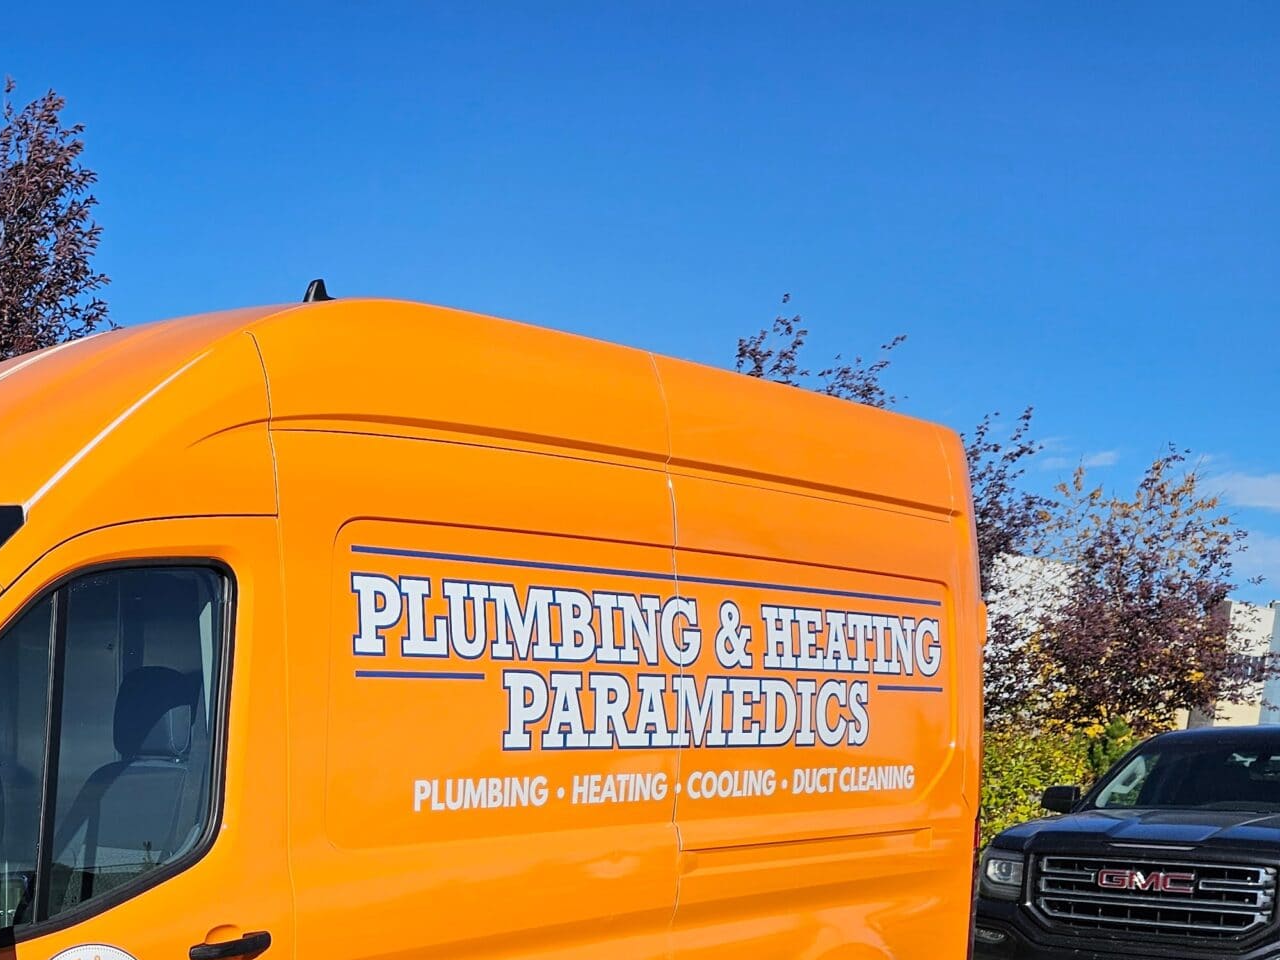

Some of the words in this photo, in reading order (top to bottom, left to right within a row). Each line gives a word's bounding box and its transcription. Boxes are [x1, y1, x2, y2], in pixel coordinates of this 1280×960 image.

[351, 572, 702, 665] PLUMBING
[715, 601, 752, 669] &
[761, 604, 942, 676] HEATING
[503, 669, 869, 751] PARAMEDICS
[414, 776, 548, 812] PLUMBING
[571, 772, 668, 804] HEATING
[687, 768, 777, 799] COOLING
[792, 766, 838, 795] DUCT
[840, 765, 915, 792] CLEANING
[1098, 869, 1194, 893] GMC
